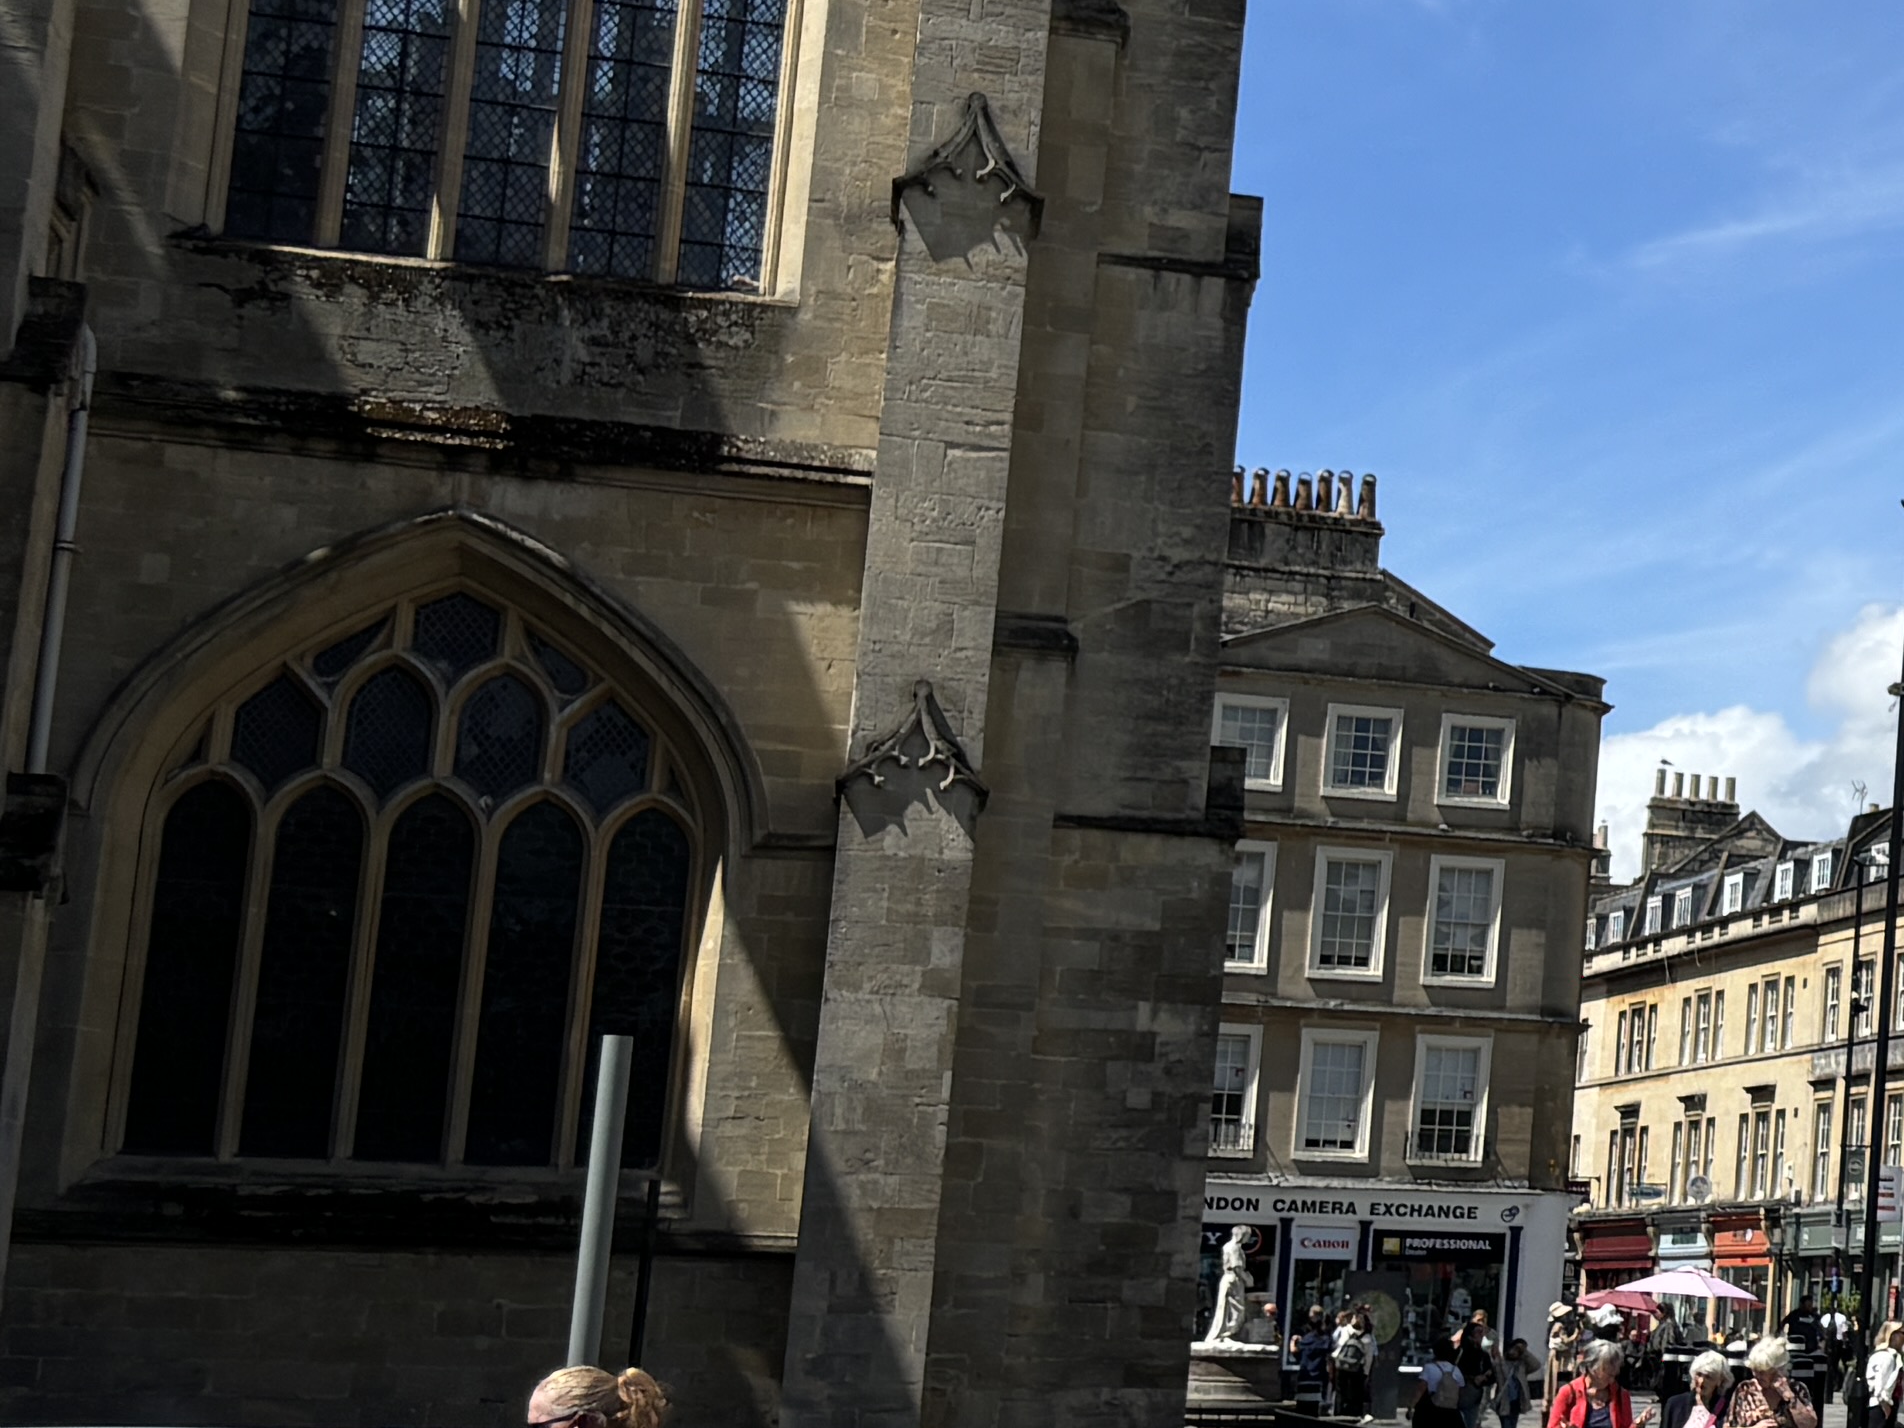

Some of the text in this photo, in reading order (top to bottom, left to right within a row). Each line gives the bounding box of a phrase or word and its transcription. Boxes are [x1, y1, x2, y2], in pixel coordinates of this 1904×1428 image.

[1273, 1198, 1357, 1216] CAMERA
[1369, 1202, 1479, 1220] EXCHANGE
[1300, 1236, 1350, 1250] Canon
[1405, 1237, 1491, 1251] PROFESSIONAL
